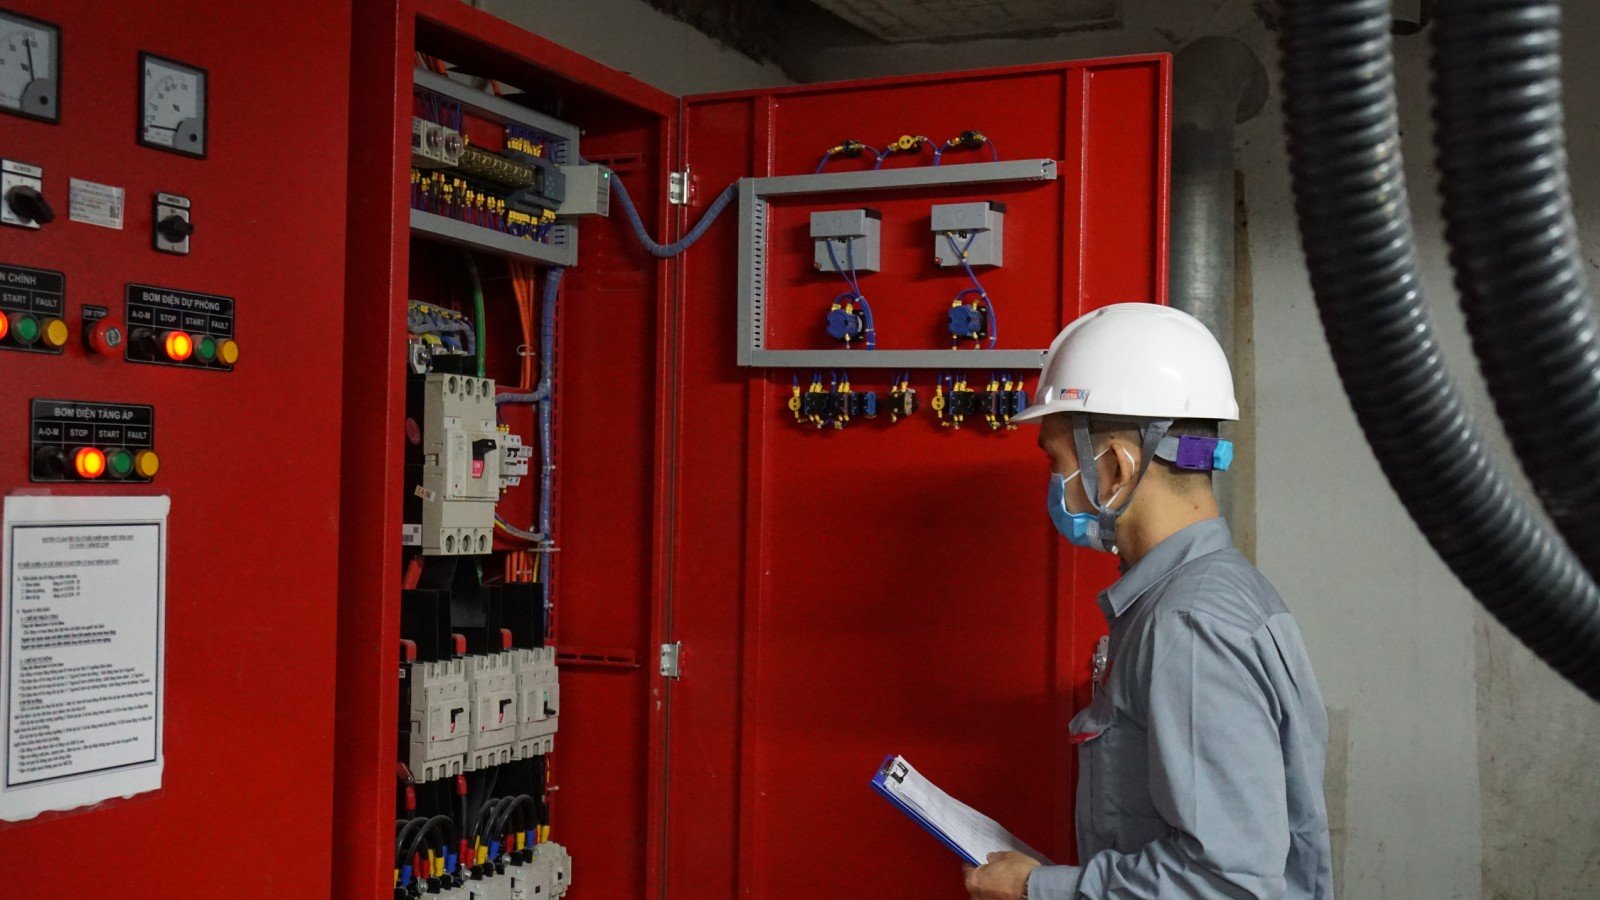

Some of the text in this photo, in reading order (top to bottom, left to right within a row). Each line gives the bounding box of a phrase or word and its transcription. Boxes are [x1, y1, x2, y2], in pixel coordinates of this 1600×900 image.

[8, 272, 37, 286] CHÍNH
[2, 293, 27, 304] START
[35, 297, 58, 308] FAULT
[142, 291, 220, 311] BƠM ĐIỆN DỰ PHÒNG
[160, 313, 177, 323] STOP
[185, 317, 205, 326] START
[211, 320, 229, 330] FAULT
[54, 407, 134, 420] BƠM ĐIỆN TĂNG ÁP
[69, 428, 89, 437] STOP
[98, 429, 121, 439] START
[127, 431, 148, 440] FAULT
